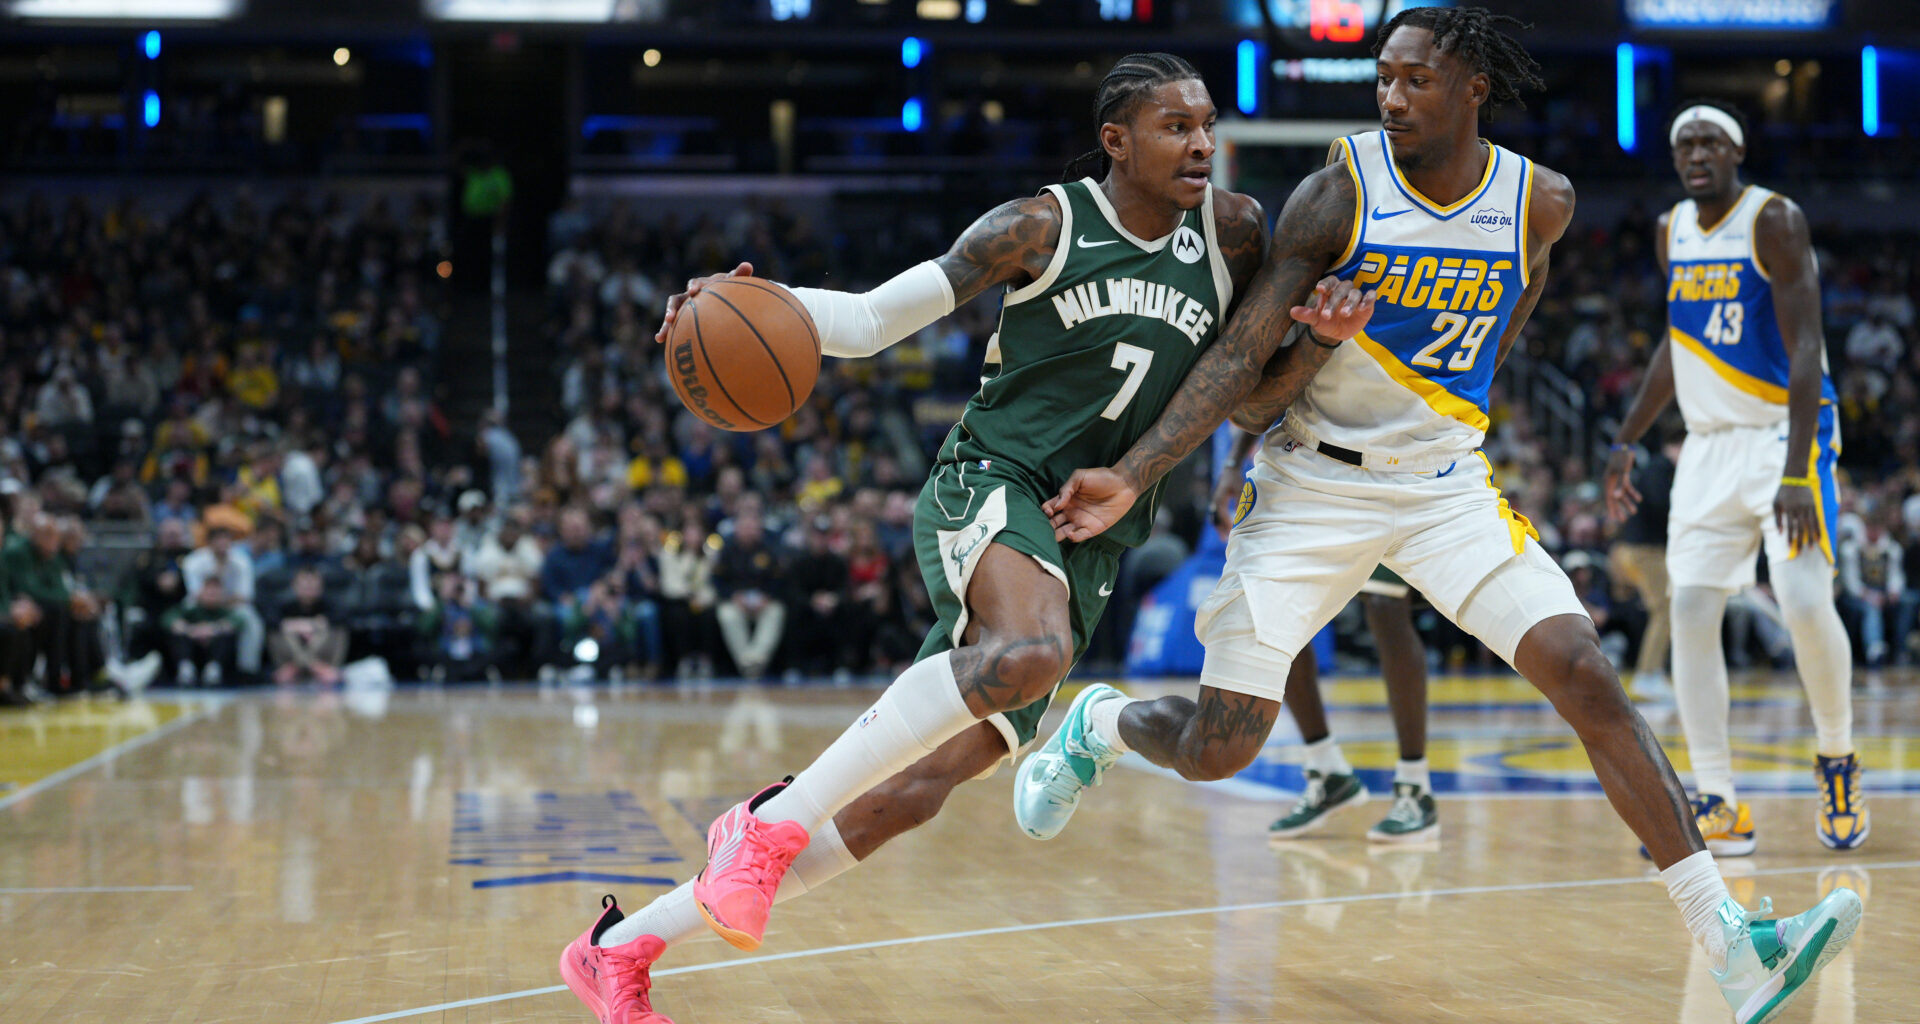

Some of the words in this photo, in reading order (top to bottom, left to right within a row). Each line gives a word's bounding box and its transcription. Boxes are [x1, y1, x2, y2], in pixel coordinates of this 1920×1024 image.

[1470, 214, 1498, 224] LUCAS
[1499, 216, 1512, 225] OIL
[1051, 277, 1214, 347] MILWAUKEE
[1352, 252, 1513, 312] PACERS
[1667, 263, 1744, 301] PACERS
[1411, 311, 1498, 372] 29
[1703, 302, 1745, 345] 43
[675, 338, 736, 429] Wilson
[1100, 341, 1155, 422] 7
